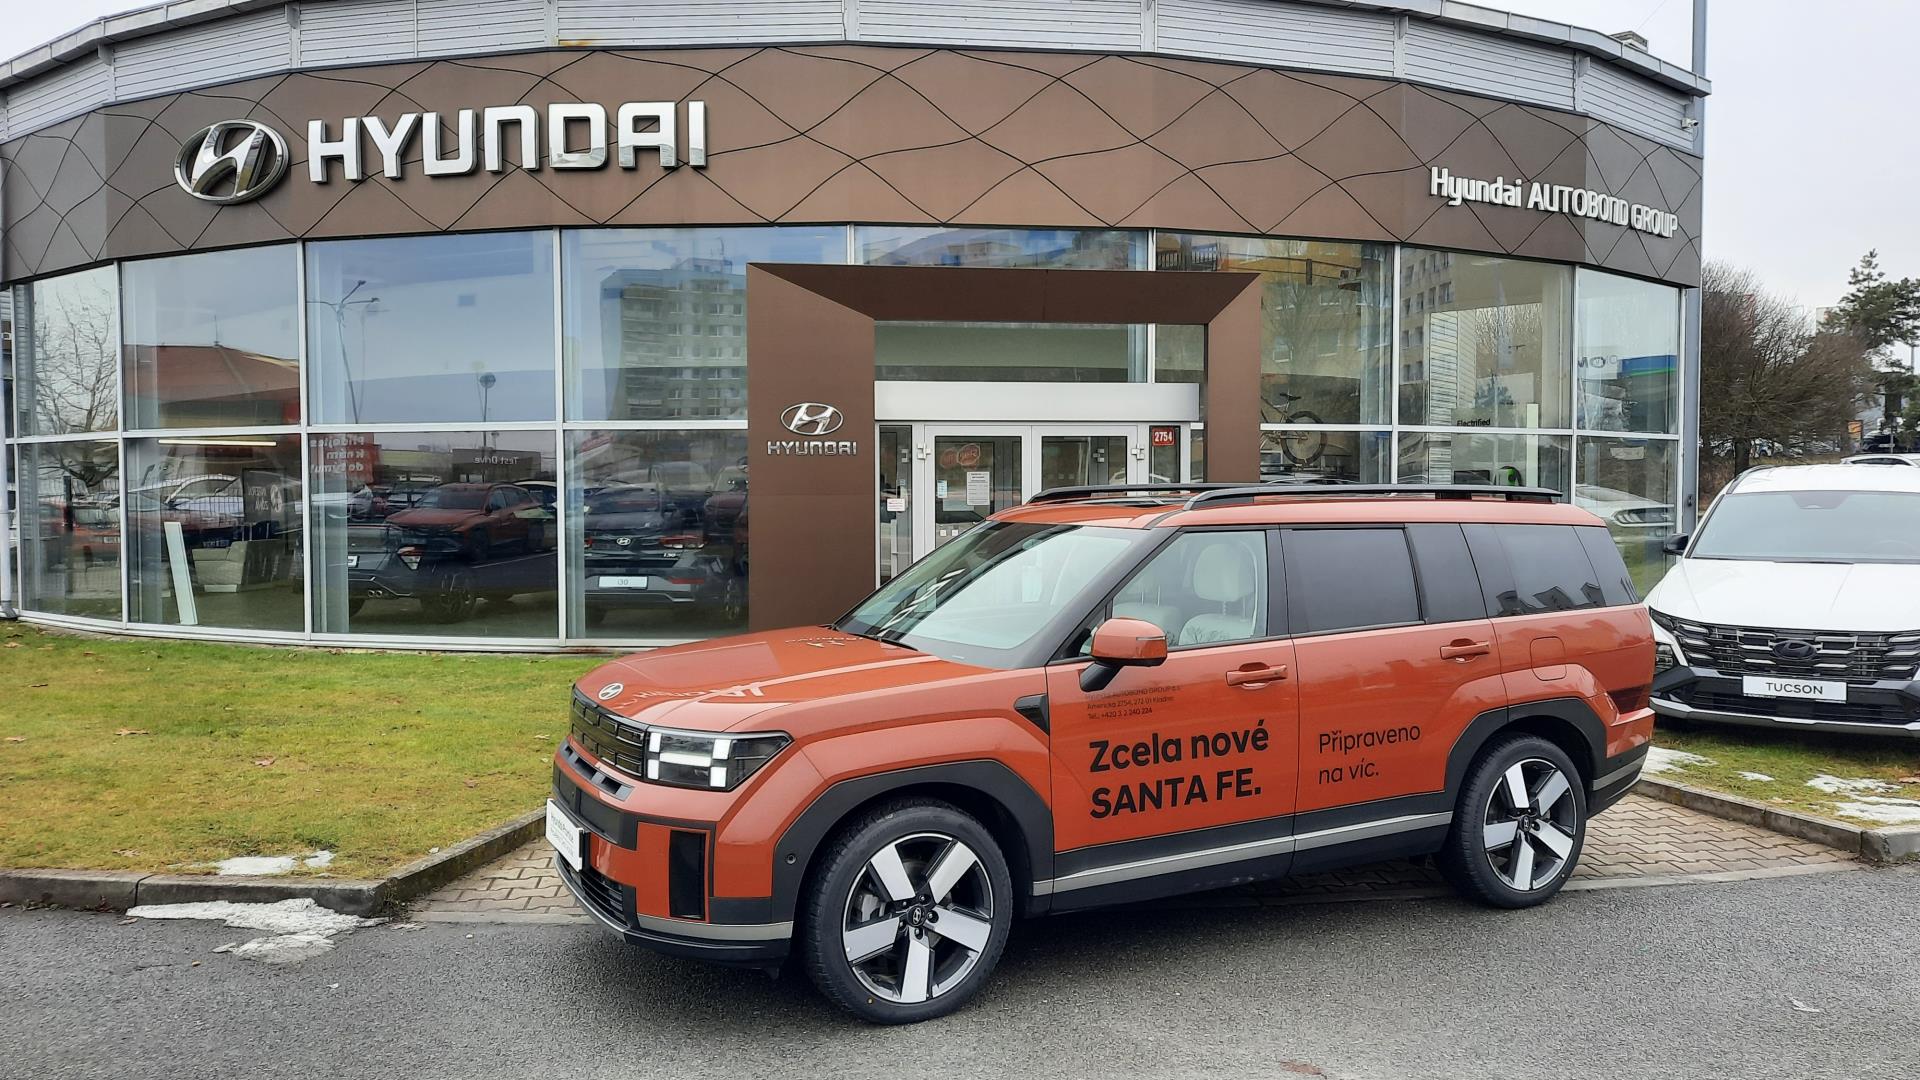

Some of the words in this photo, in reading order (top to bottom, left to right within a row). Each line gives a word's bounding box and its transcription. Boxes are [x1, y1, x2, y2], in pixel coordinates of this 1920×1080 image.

[307, 100, 708, 184] HYUNDAI
[1430, 166, 1523, 206] Hyundai
[1527, 181, 1629, 227] AUTOBOND
[1630, 203, 1679, 239] GROUP
[1154, 431, 1174, 442] 2754
[1456, 418, 1491, 427] Electrified
[767, 440, 857, 456] HYUNDAI
[1765, 682, 1824, 695] TUCSON
[1089, 732, 1182, 773] Zcela
[1191, 719, 1269, 759] nové
[1318, 725, 1421, 755] Připraveno
[1318, 767, 1343, 785] na
[1348, 757, 1379, 780] víc.
[1090, 774, 1208, 819] SANTA
[1216, 767, 1262, 801] FE.
